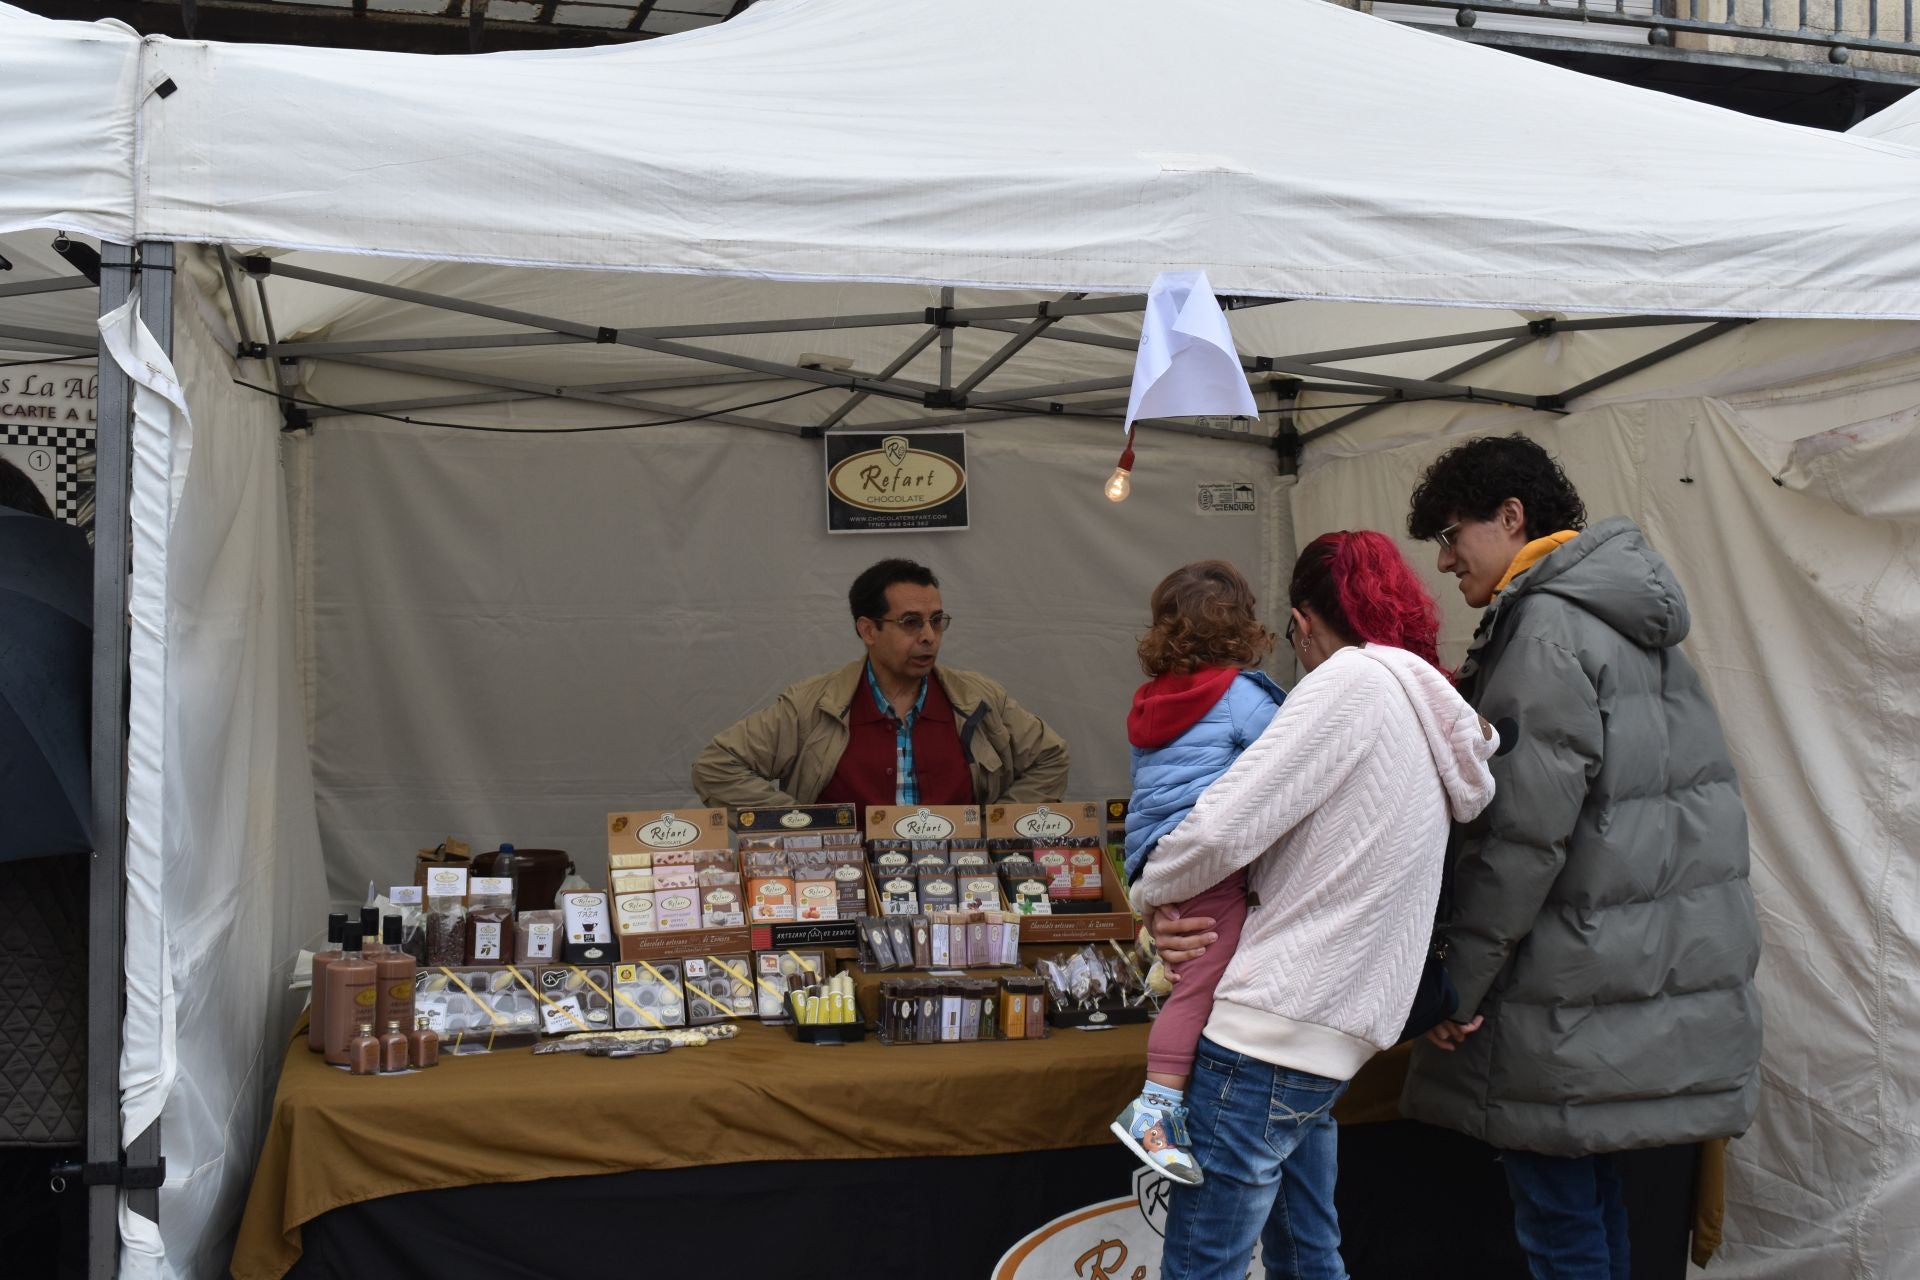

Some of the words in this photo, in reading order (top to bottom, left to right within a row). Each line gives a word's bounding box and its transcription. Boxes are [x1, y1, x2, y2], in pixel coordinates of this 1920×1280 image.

[19, 374, 55, 397] La
[0, 403, 57, 420] CARTE
[66, 408, 79, 421] A
[36, 454, 42, 467] 1
[860, 465, 935, 493] Refart
[866, 494, 925, 504] CHOCOLATE
[1223, 503, 1255, 511] ENDURO
[907, 820, 941, 834] Refart
[1027, 819, 1060, 832] Refart
[650, 827, 686, 841] Refart
